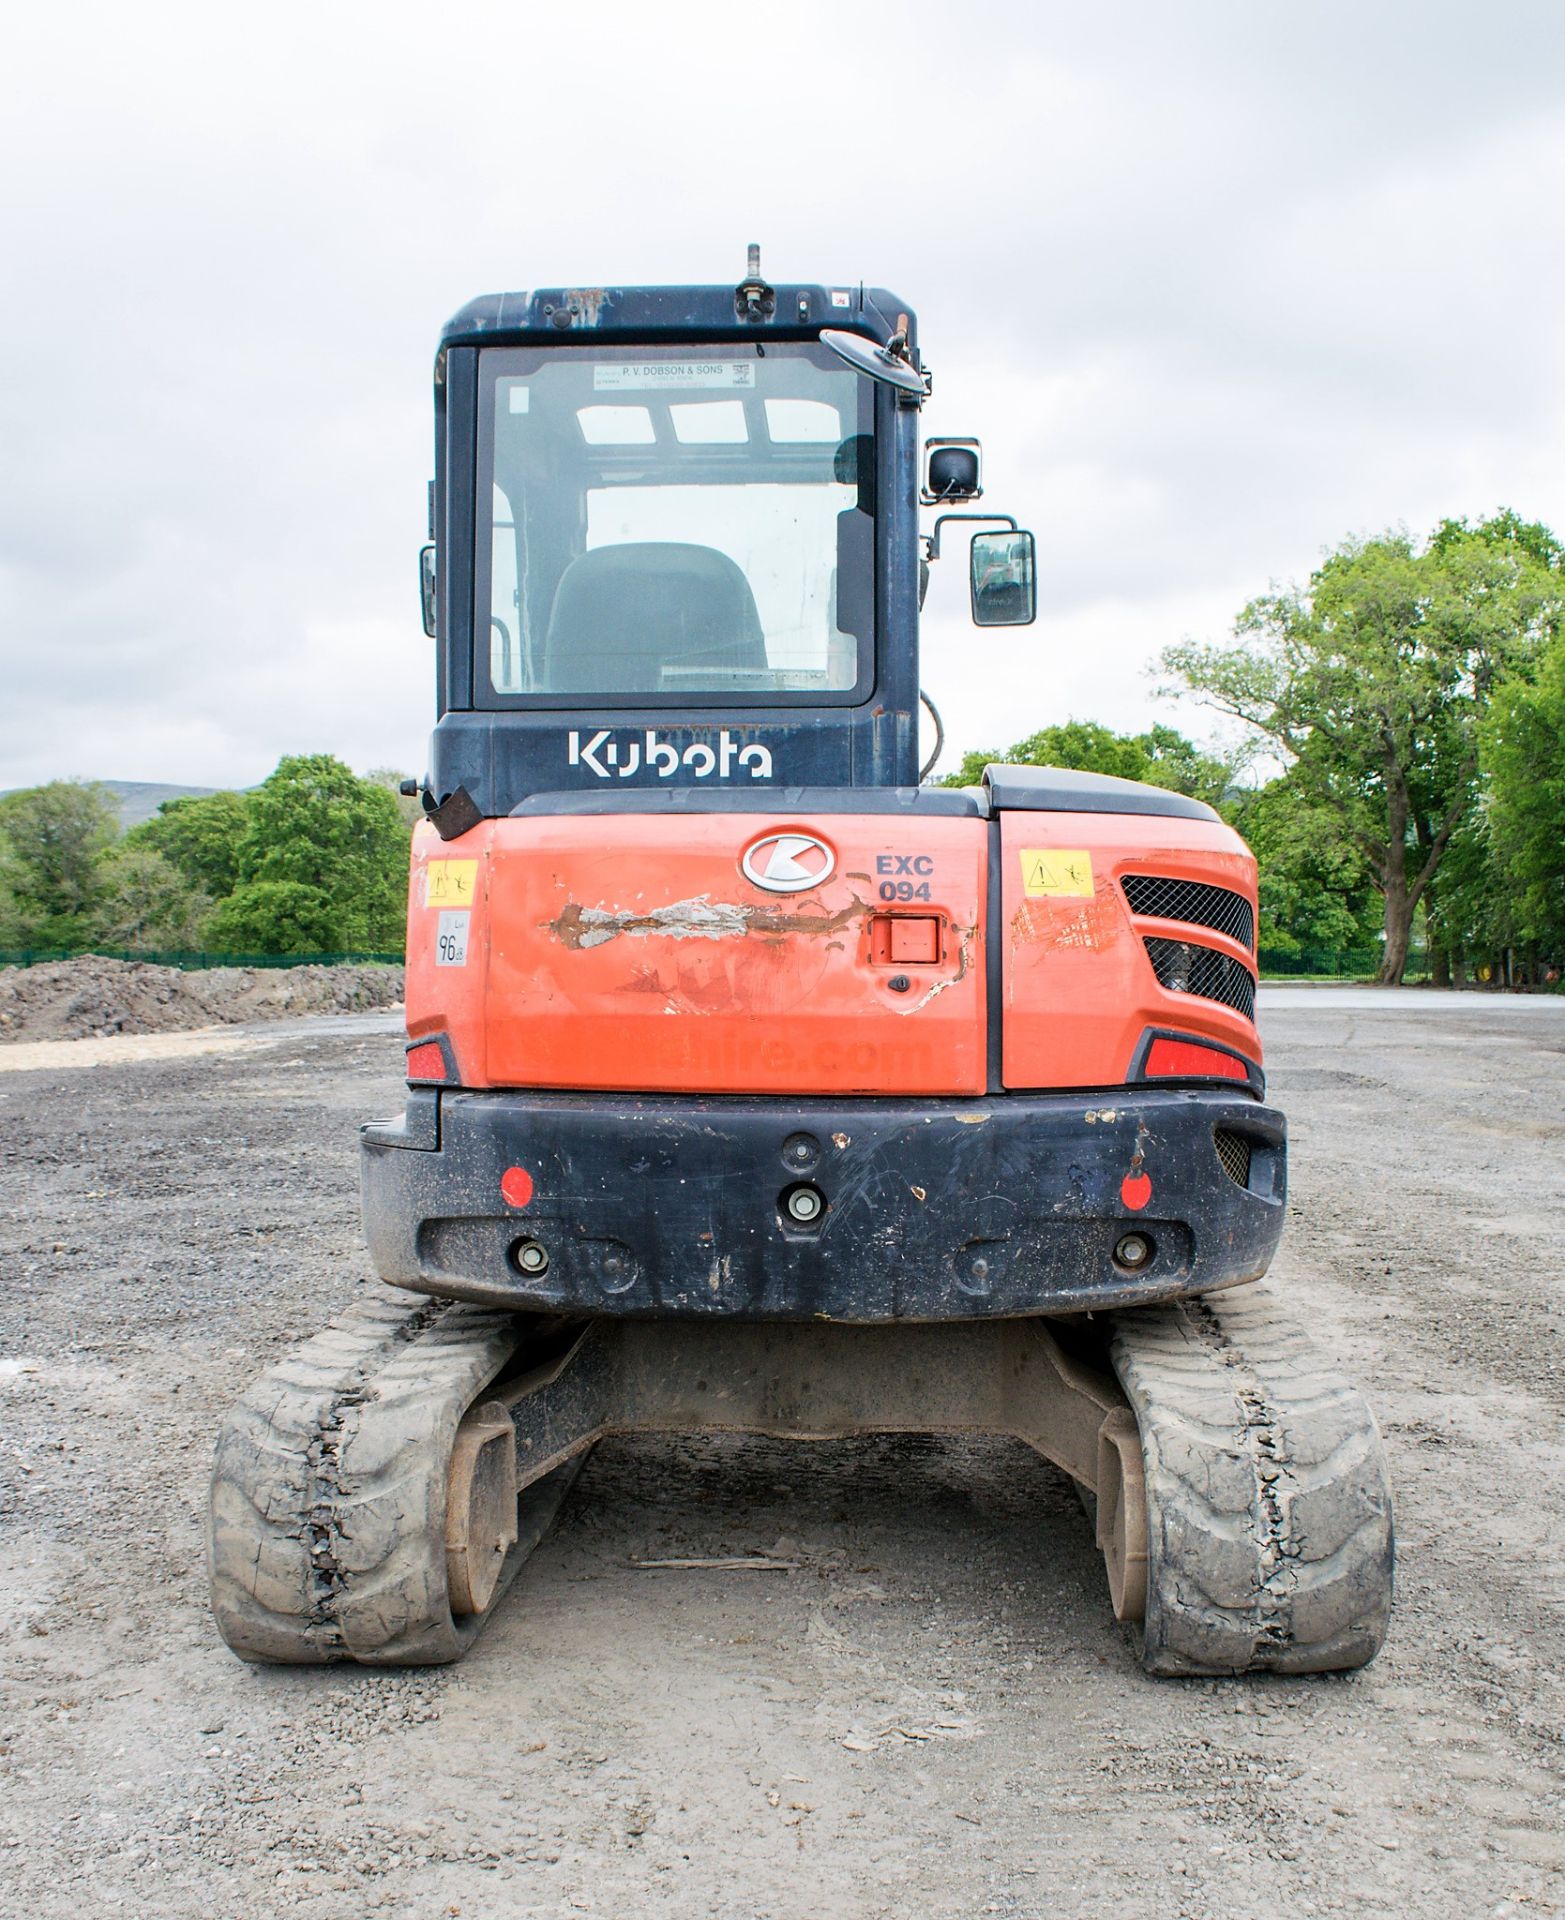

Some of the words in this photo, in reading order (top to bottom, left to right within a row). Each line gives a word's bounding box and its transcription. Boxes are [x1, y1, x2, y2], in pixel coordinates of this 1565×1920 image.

[622, 367, 630, 376] P.
[633, 367, 641, 376] V.
[643, 366, 685, 376] DOBSON
[687, 366, 694, 374] &
[696, 365, 723, 374] SONS
[568, 731, 773, 778] Kubota
[876, 855, 934, 877] EXC
[879, 881, 932, 902] 094
[439, 935, 456, 961] 96
